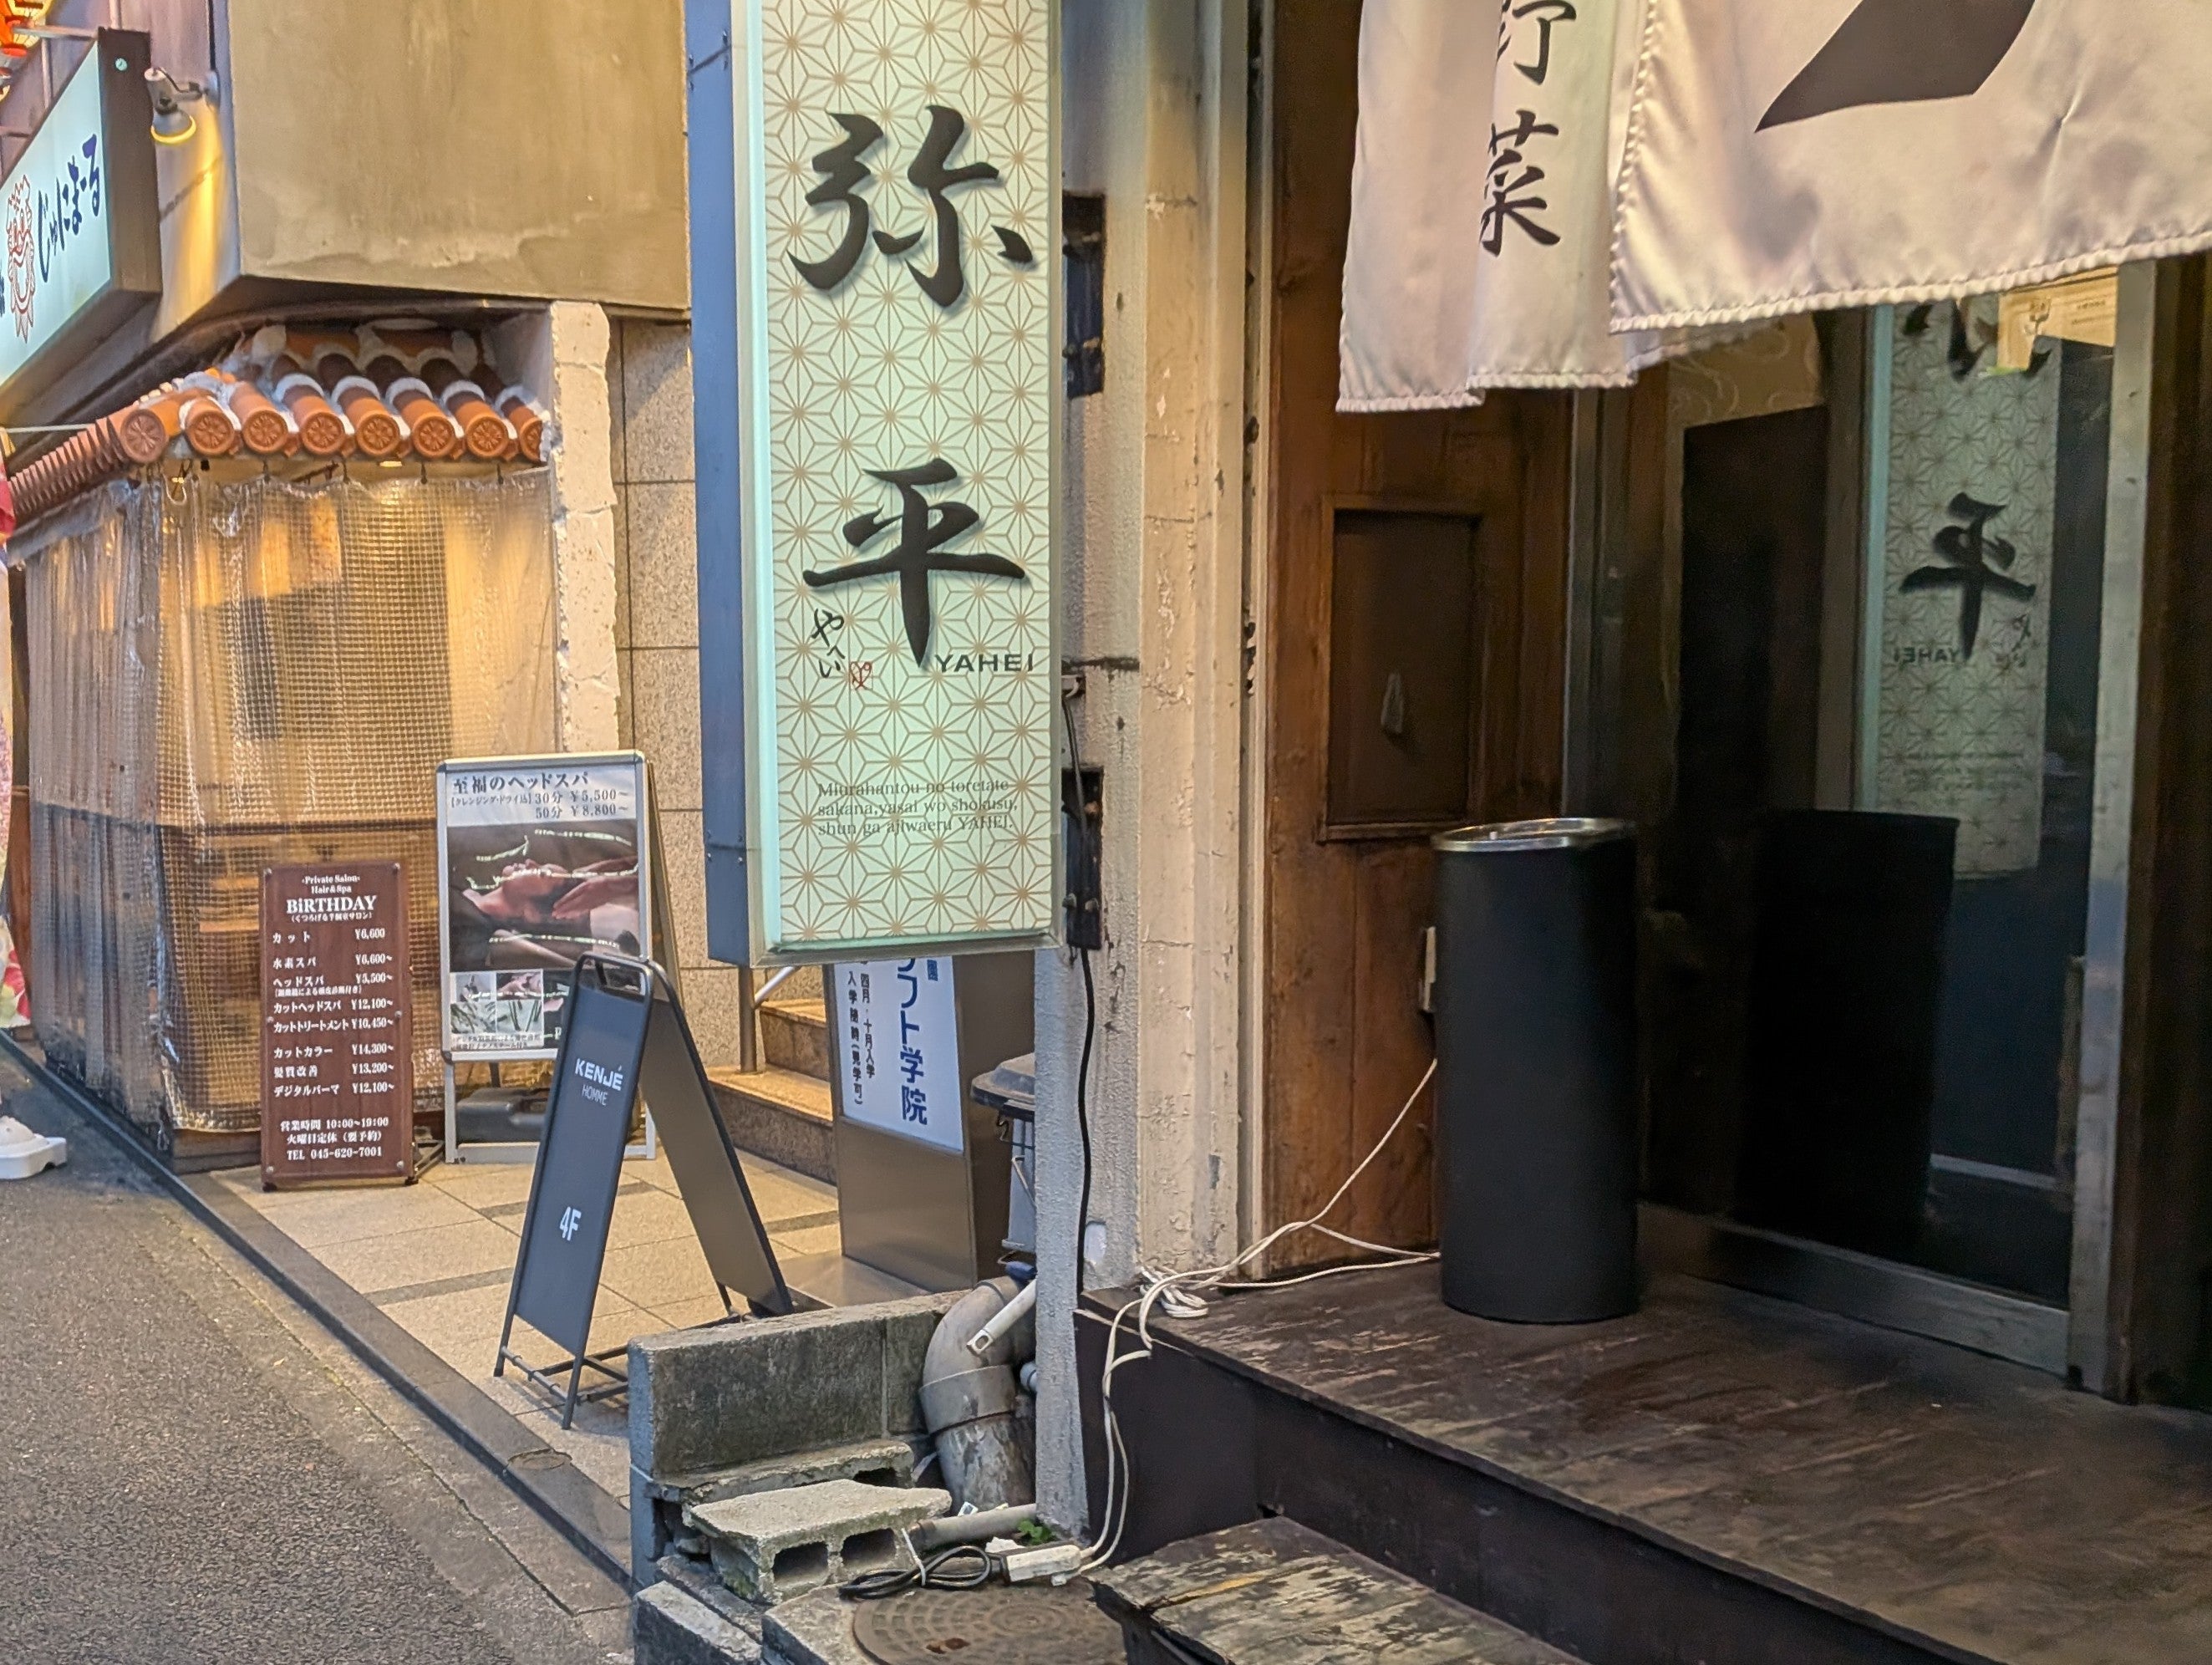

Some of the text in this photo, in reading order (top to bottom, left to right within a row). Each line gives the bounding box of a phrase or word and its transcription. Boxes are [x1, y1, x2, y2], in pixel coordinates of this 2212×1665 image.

[786, 105, 1034, 667] 弥平
[935, 654, 1033, 672] YAHEI
[453, 771, 588, 794] 至福のヘッドスパ
[818, 781, 1009, 797] Miurahantou no toretate
[535, 791, 562, 803] 30分
[535, 805, 562, 819] 50分
[924, 802, 946, 812] wo
[818, 822, 857, 836] shun
[863, 823, 880, 837] ga
[272, 930, 311, 945] カット
[272, 975, 324, 988] ヘッドスパ
[273, 1000, 342, 1014] カットヘッドスパ
[273, 1019, 349, 1034] カットトリートメント
[273, 1046, 333, 1059] カットカラー
[582, 1084, 608, 1106] HOMME
[287, 1149, 306, 1160] TEL
[559, 1206, 582, 1241] 4F
